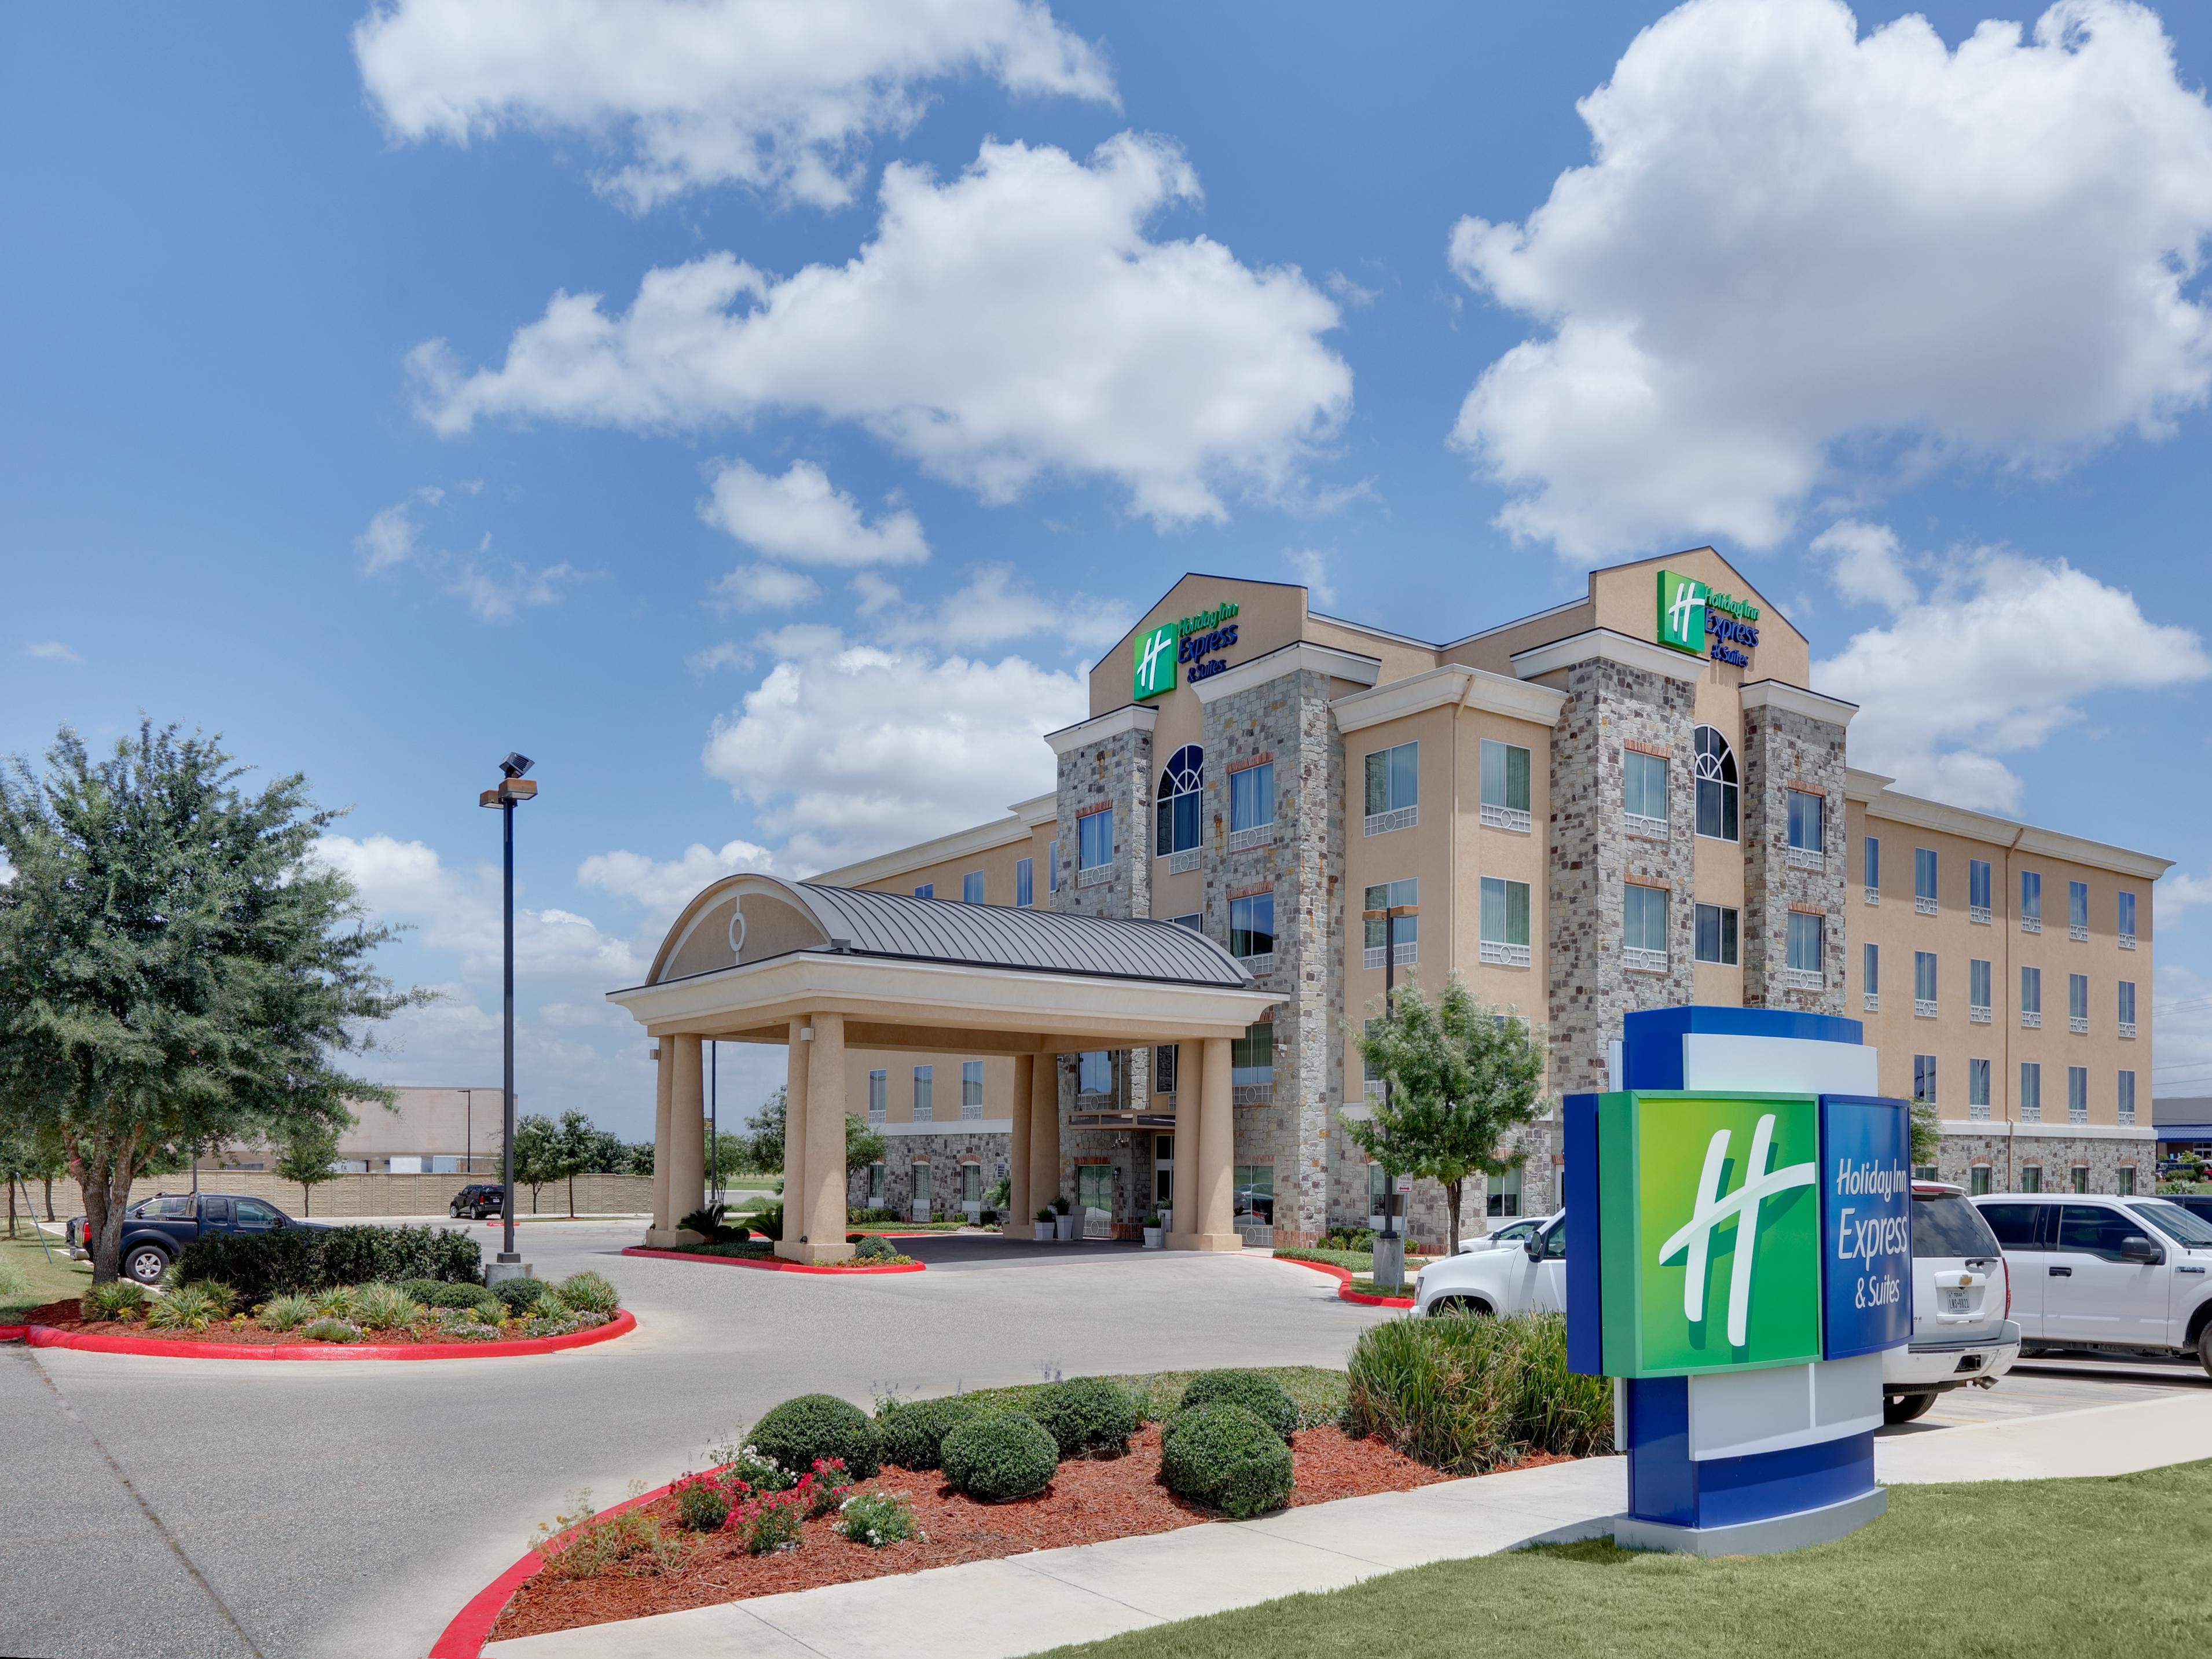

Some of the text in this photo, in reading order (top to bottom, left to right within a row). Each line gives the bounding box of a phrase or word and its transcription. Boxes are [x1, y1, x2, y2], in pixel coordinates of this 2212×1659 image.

[1177, 602, 1238, 637] Holiday Inn
[1704, 586, 1760, 621] Holiday Inn
[1178, 625, 1238, 663] Express
[1705, 607, 1759, 647] Express
[1187, 659, 1227, 682] & Suites
[1711, 644, 1748, 667] & Suites
[1836, 1158, 1906, 1203] Holiday Inn
[1838, 1207, 1907, 1272] Express
[1855, 1275, 1899, 1309] & Suites
